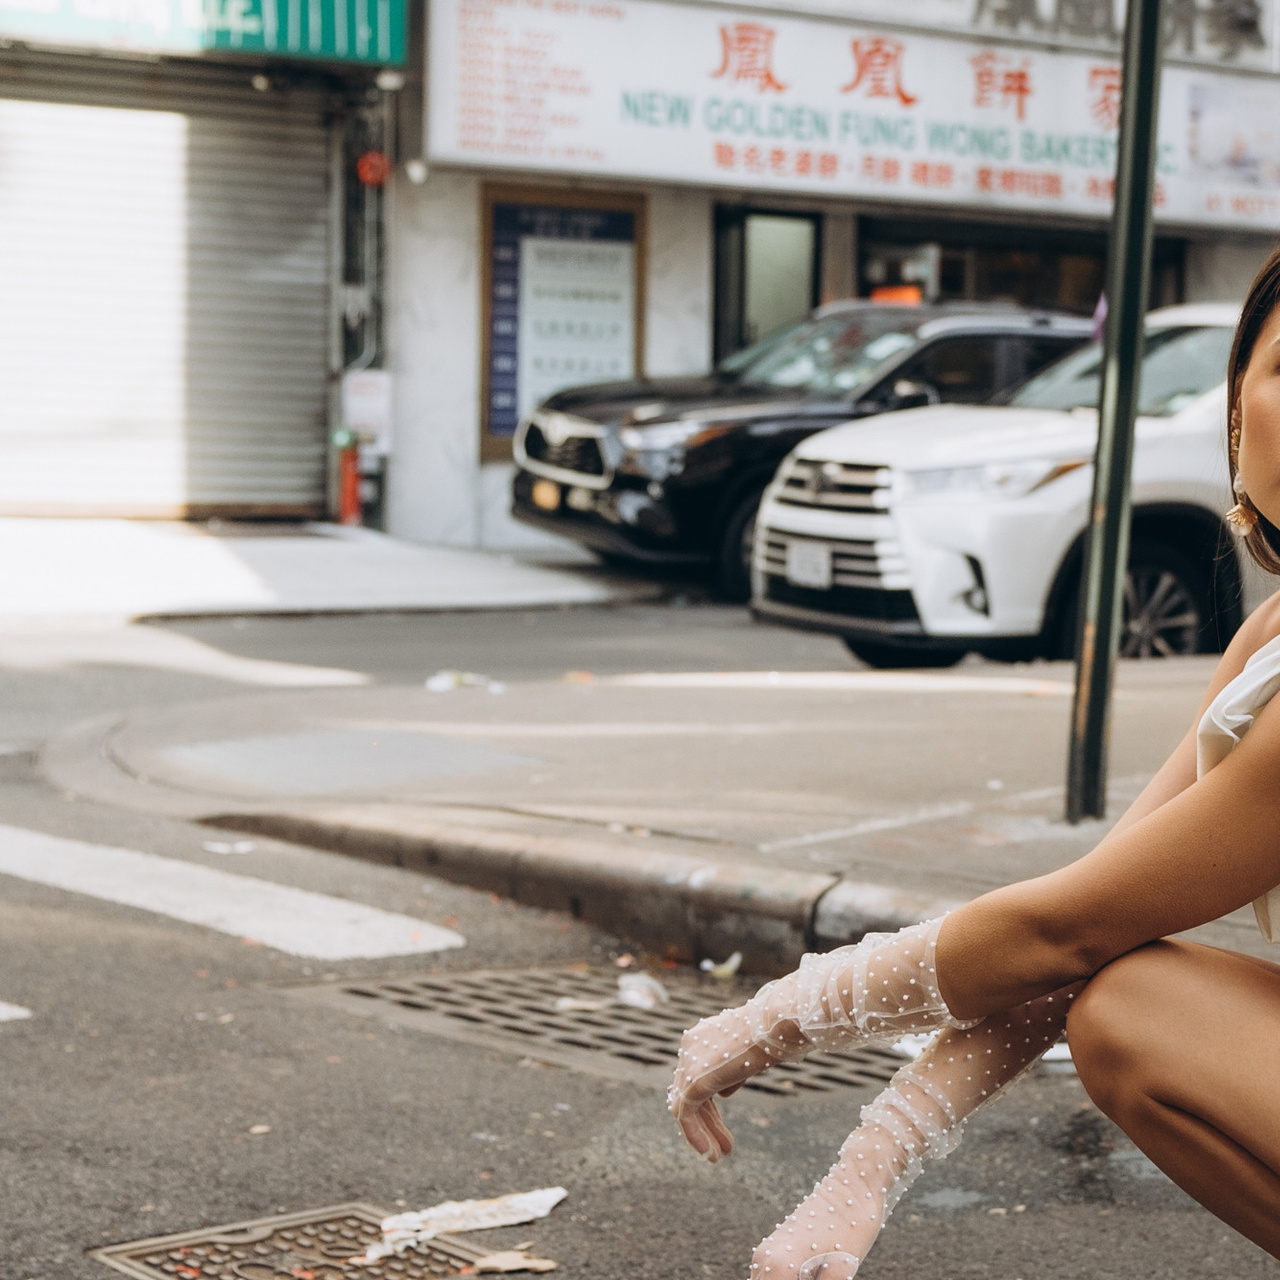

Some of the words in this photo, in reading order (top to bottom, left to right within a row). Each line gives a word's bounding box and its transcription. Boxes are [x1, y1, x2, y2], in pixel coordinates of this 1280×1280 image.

[620, 90, 695, 128] NEW
[704, 97, 830, 141] GOLDEN
[839, 108, 917, 151] FUNG
[927, 121, 1010, 161] WONG
[1020, 129, 1120, 169] BAKER
